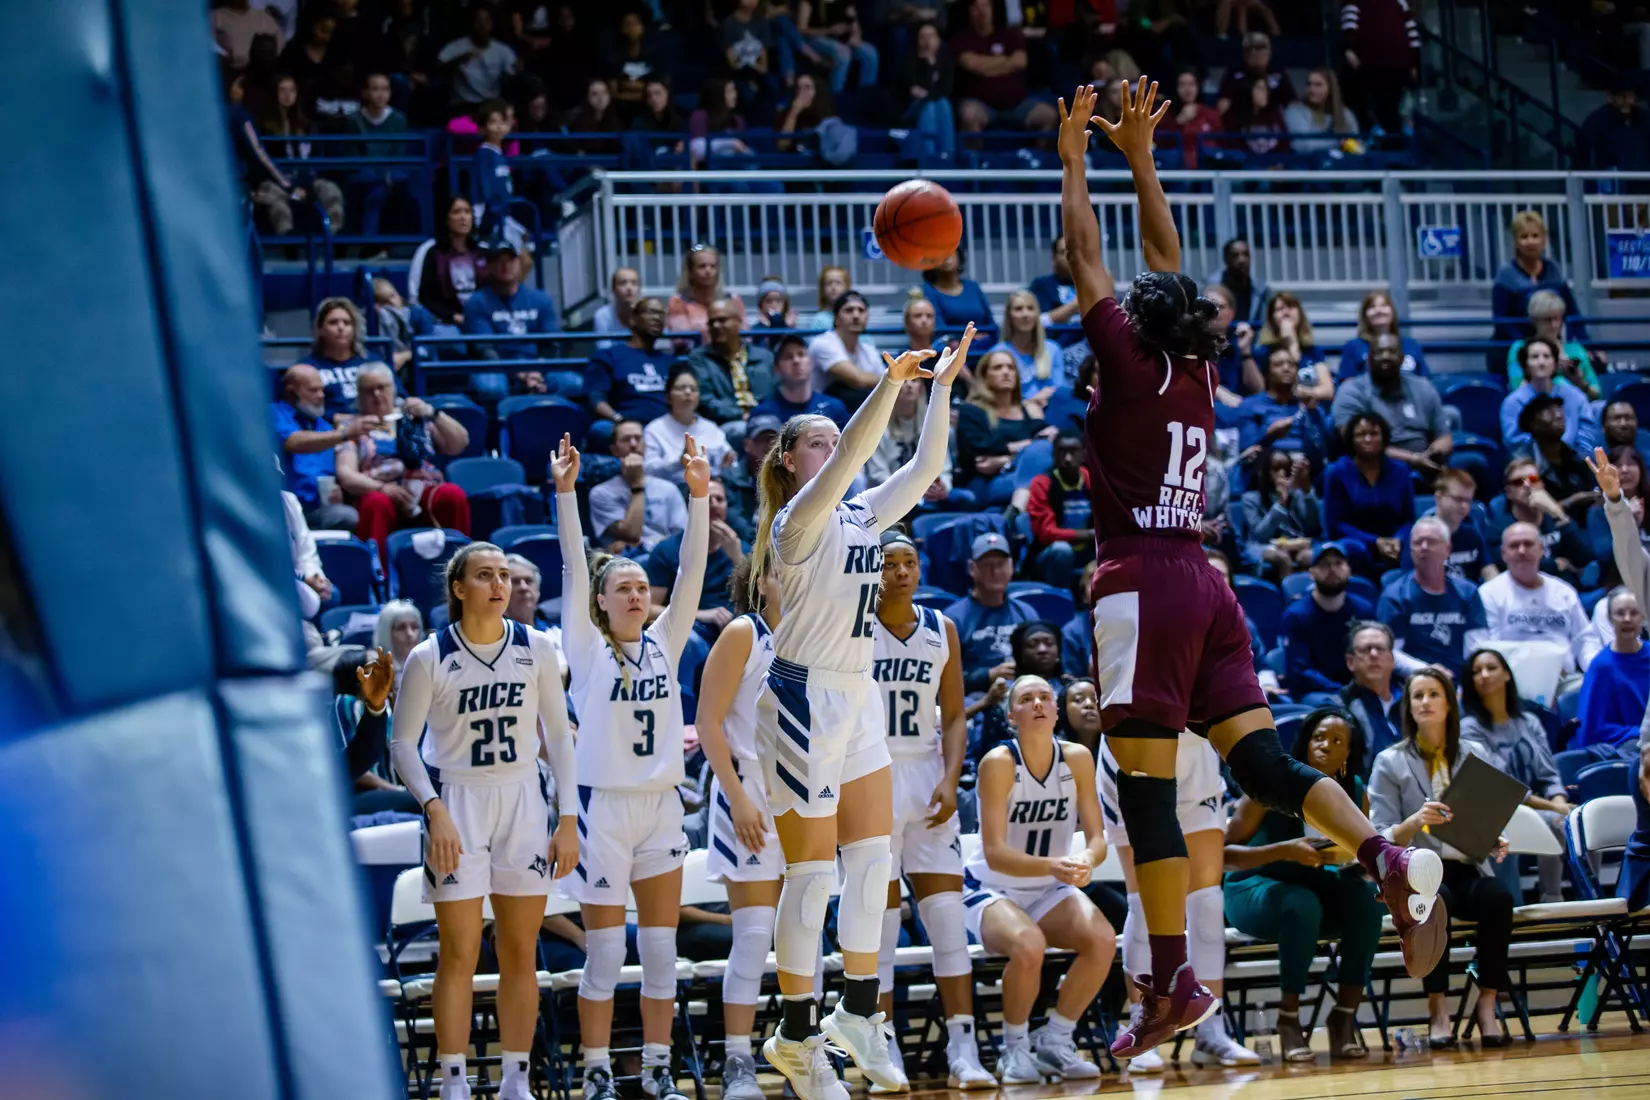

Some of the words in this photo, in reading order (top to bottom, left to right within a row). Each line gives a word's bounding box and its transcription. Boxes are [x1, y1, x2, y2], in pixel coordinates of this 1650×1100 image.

[1163, 421, 1206, 492] 12
[873, 657, 933, 685] RICE
[458, 682, 526, 715] RICE
[888, 690, 920, 737] 12
[470, 716, 518, 767] 25
[633, 709, 655, 757] 3
[1009, 797, 1069, 824] RICE
[1025, 829, 1052, 857] 11
